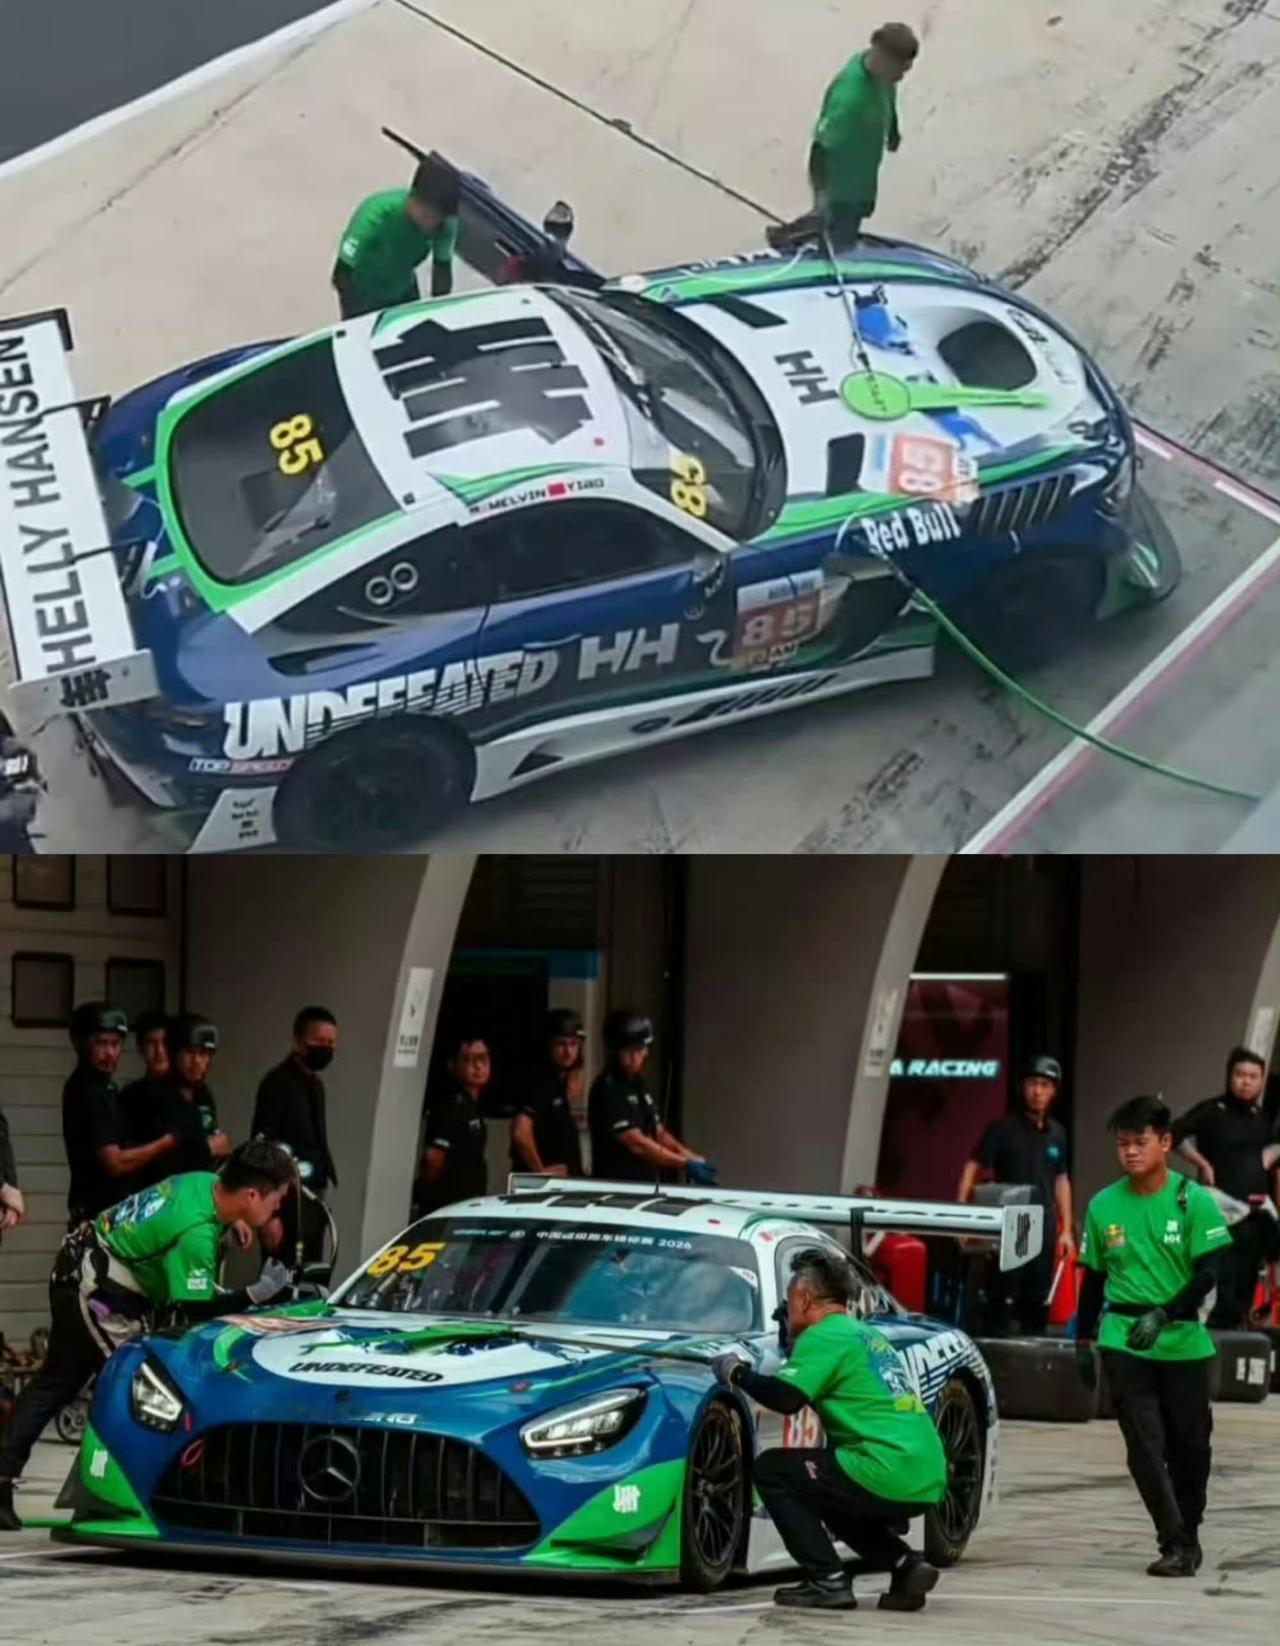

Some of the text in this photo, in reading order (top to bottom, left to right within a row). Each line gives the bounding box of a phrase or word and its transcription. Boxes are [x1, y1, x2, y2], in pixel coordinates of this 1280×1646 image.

[775, 350, 838, 404] HH
[270, 414, 324, 475] 85
[488, 488, 547, 510] MELVIN
[861, 502, 961, 555] Red Bull
[19, 523, 96, 674] HELLY
[223, 624, 680, 760] UNDEFEATED HH
[907, 1059, 1000, 1077] RACING
[366, 1242, 446, 1278] 85
[288, 1361, 444, 1383] UNDEFEATED
